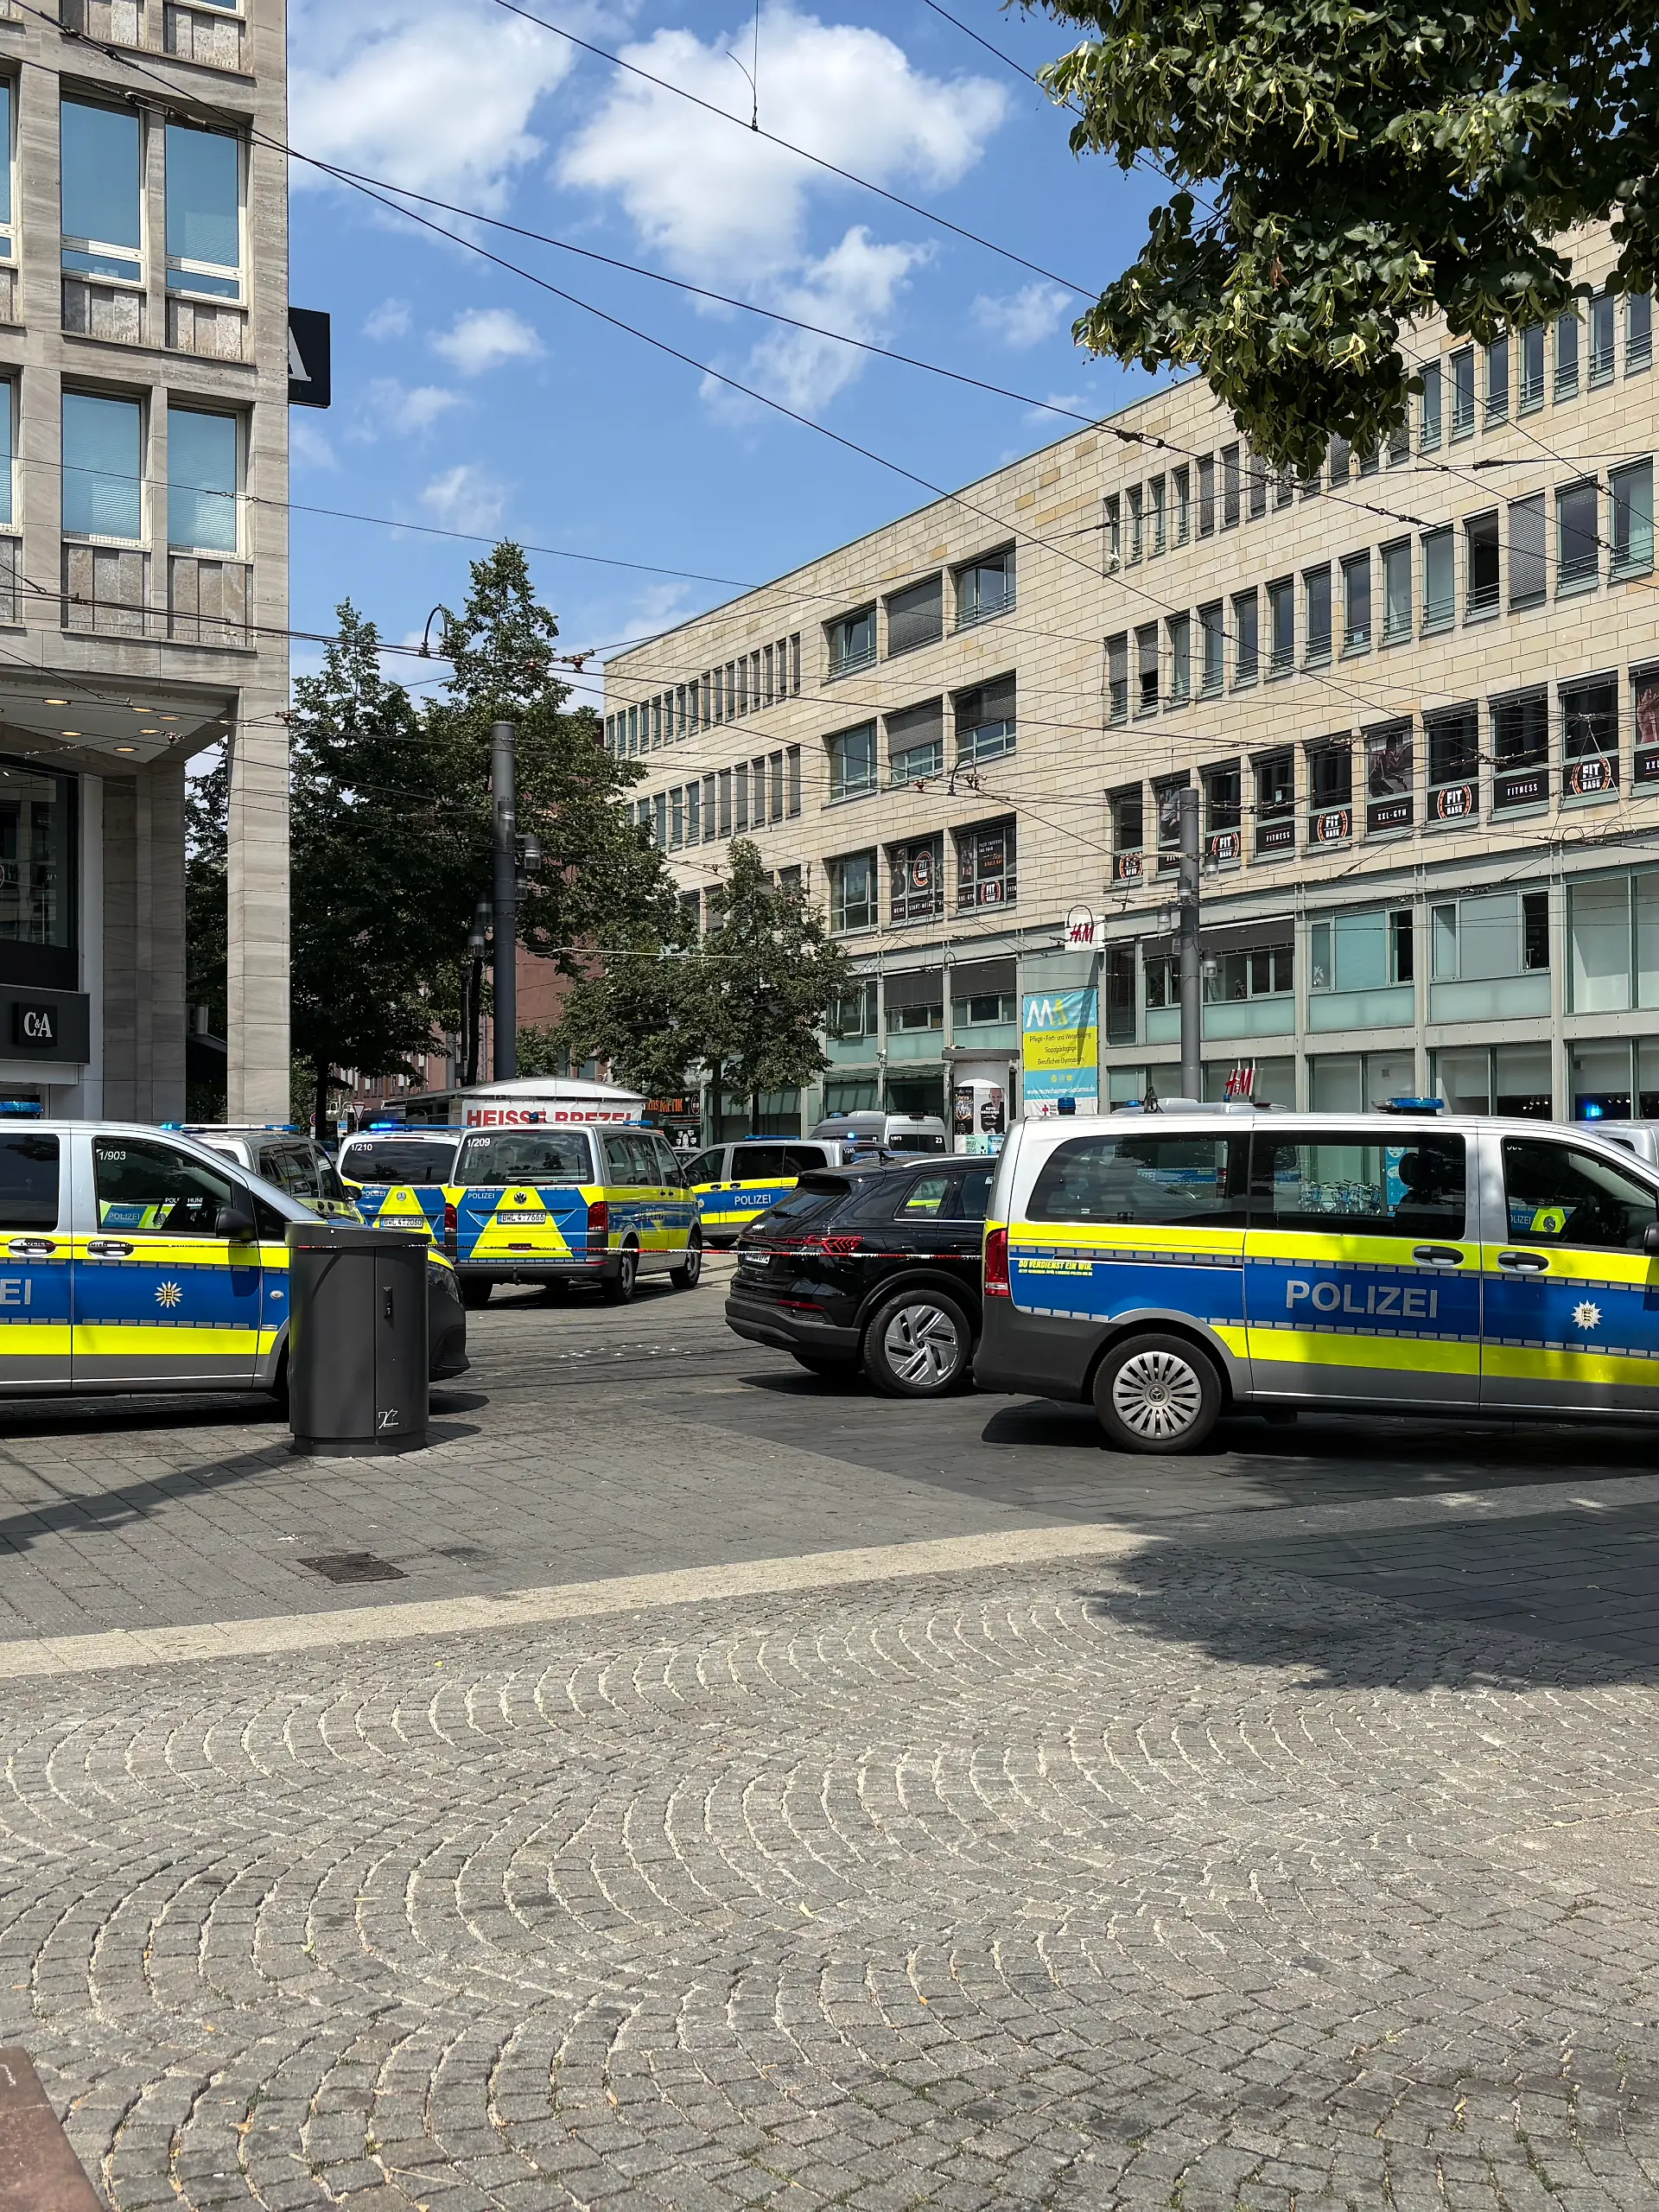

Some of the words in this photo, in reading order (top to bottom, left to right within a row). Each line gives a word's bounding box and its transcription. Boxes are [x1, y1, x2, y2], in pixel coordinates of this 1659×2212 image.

[1507, 783, 1538, 797] FITNESS
[1446, 790, 1462, 804] FIT
[1377, 809, 1407, 821] XXL-GYM
[1446, 805, 1463, 816] BASE
[1266, 831, 1290, 842] FITNESS
[1325, 829, 1340, 838] BASE
[1219, 836, 1231, 849] FIT
[1219, 849, 1232, 858] BASE
[23, 1011, 53, 1038] C&A
[351, 1143, 372, 1152] 1/210
[467, 1138, 491, 1147] 1/209
[99, 1150, 126, 1160] 1/903
[467, 1191, 495, 1199] POLIZEI
[734, 1194, 772, 1206] POLIZEI
[109, 1212, 140, 1221] POLIZEI
[1018, 1260, 1028, 1268] DU
[1028, 1261, 1065, 1270] VERDIENST
[1065, 1262, 1077, 1270] EIN
[1286, 1280, 1438, 1319] POLIZEI
